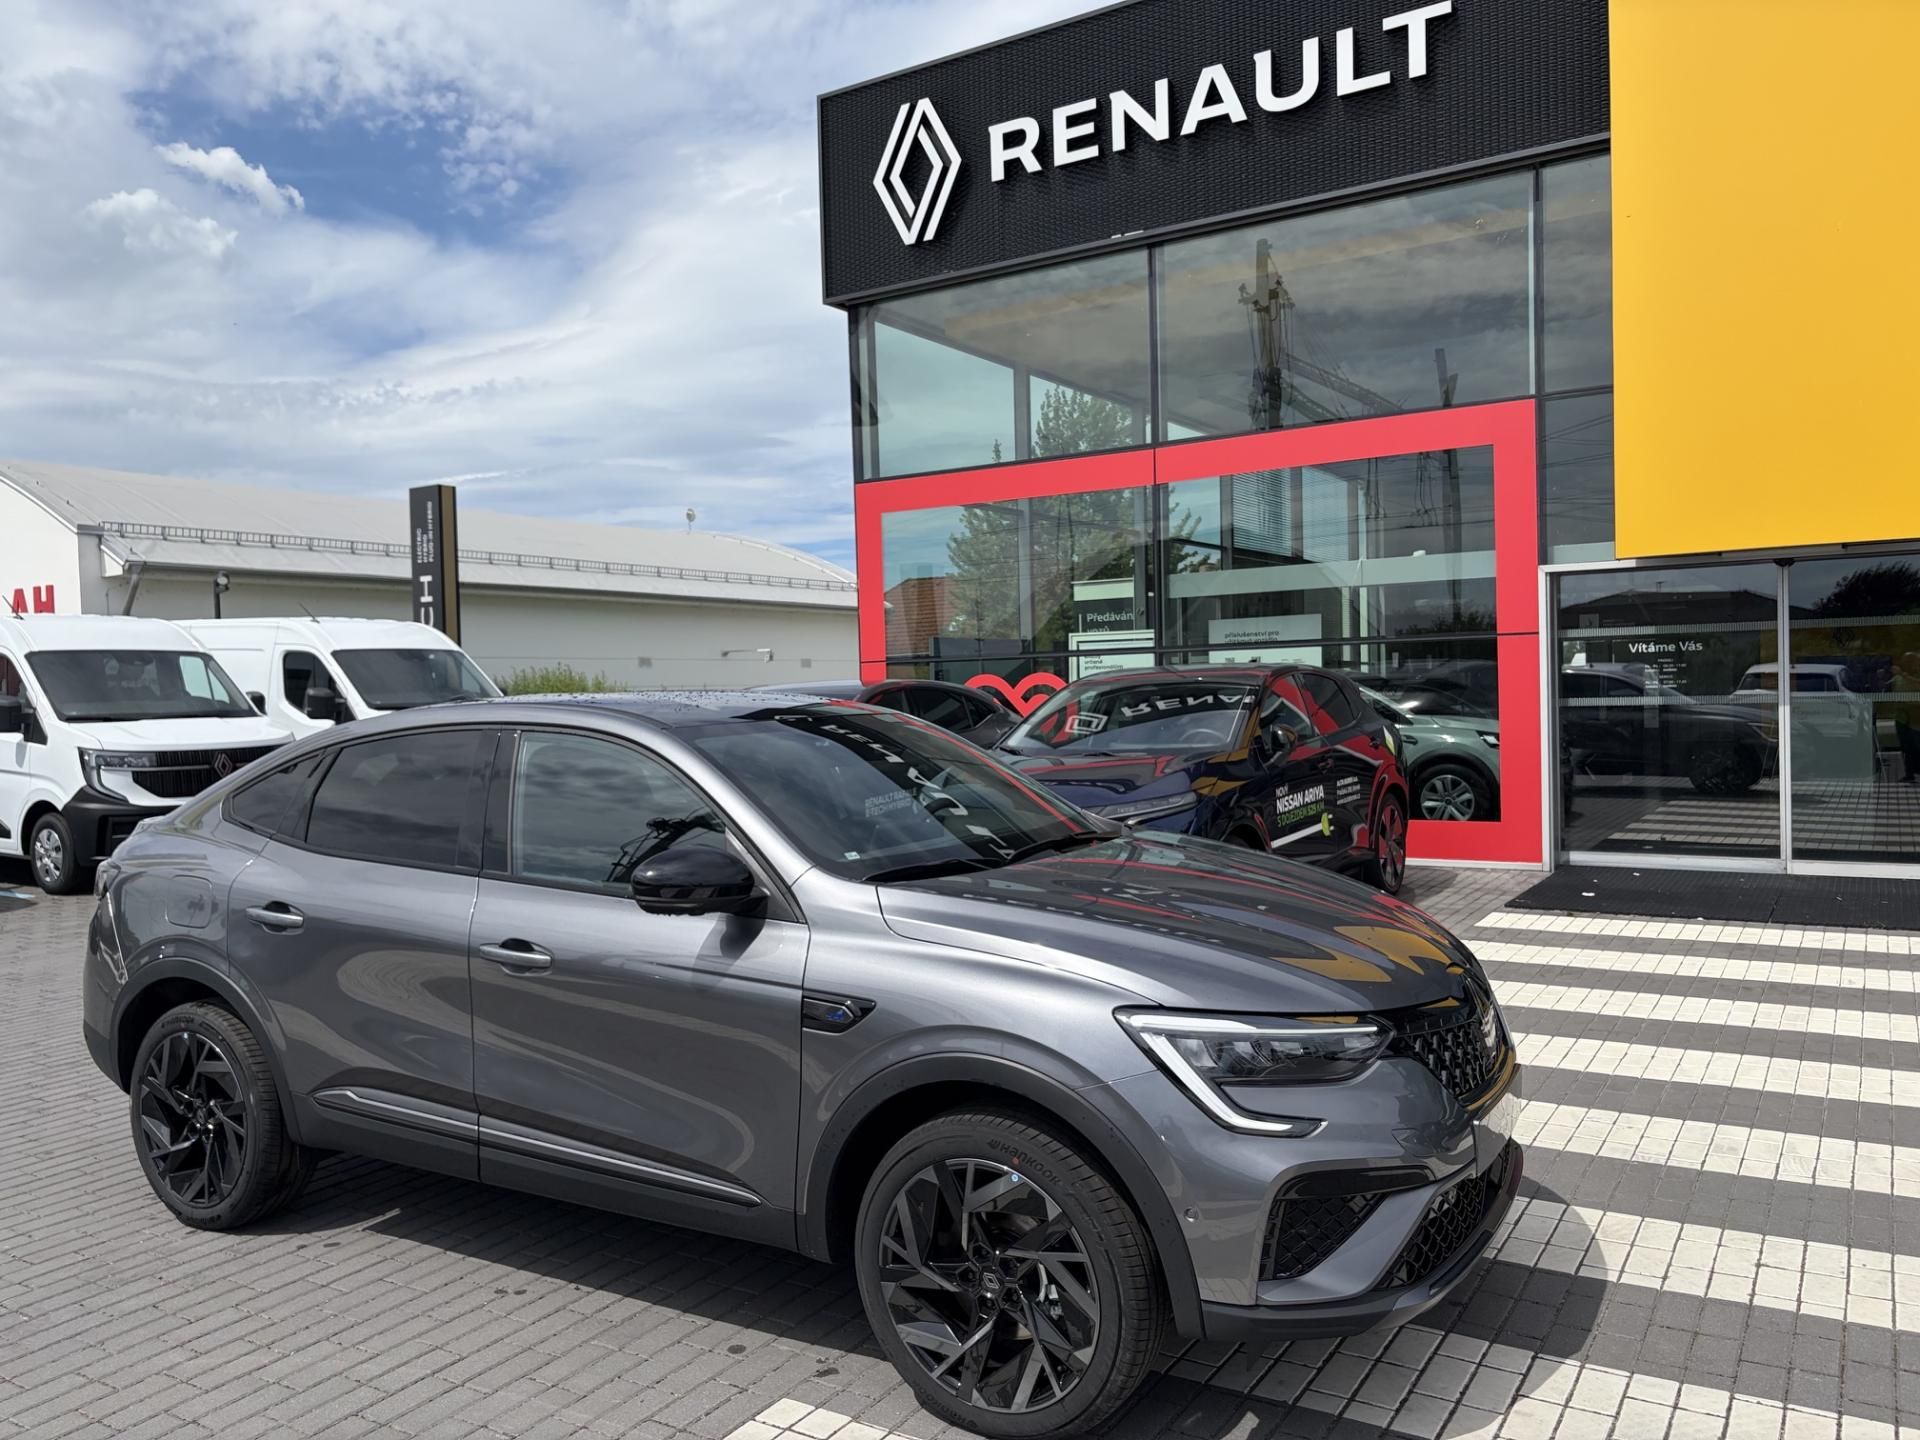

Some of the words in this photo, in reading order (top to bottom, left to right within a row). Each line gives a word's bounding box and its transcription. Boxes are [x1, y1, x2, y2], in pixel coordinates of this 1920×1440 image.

[988, 0, 1452, 183] RENAULT
[1629, 642, 1676, 653] Vítáme
[1678, 640, 1703, 652] Vás
[1276, 792, 1303, 814] NISSAN
[1304, 785, 1324, 804] ARIYA
